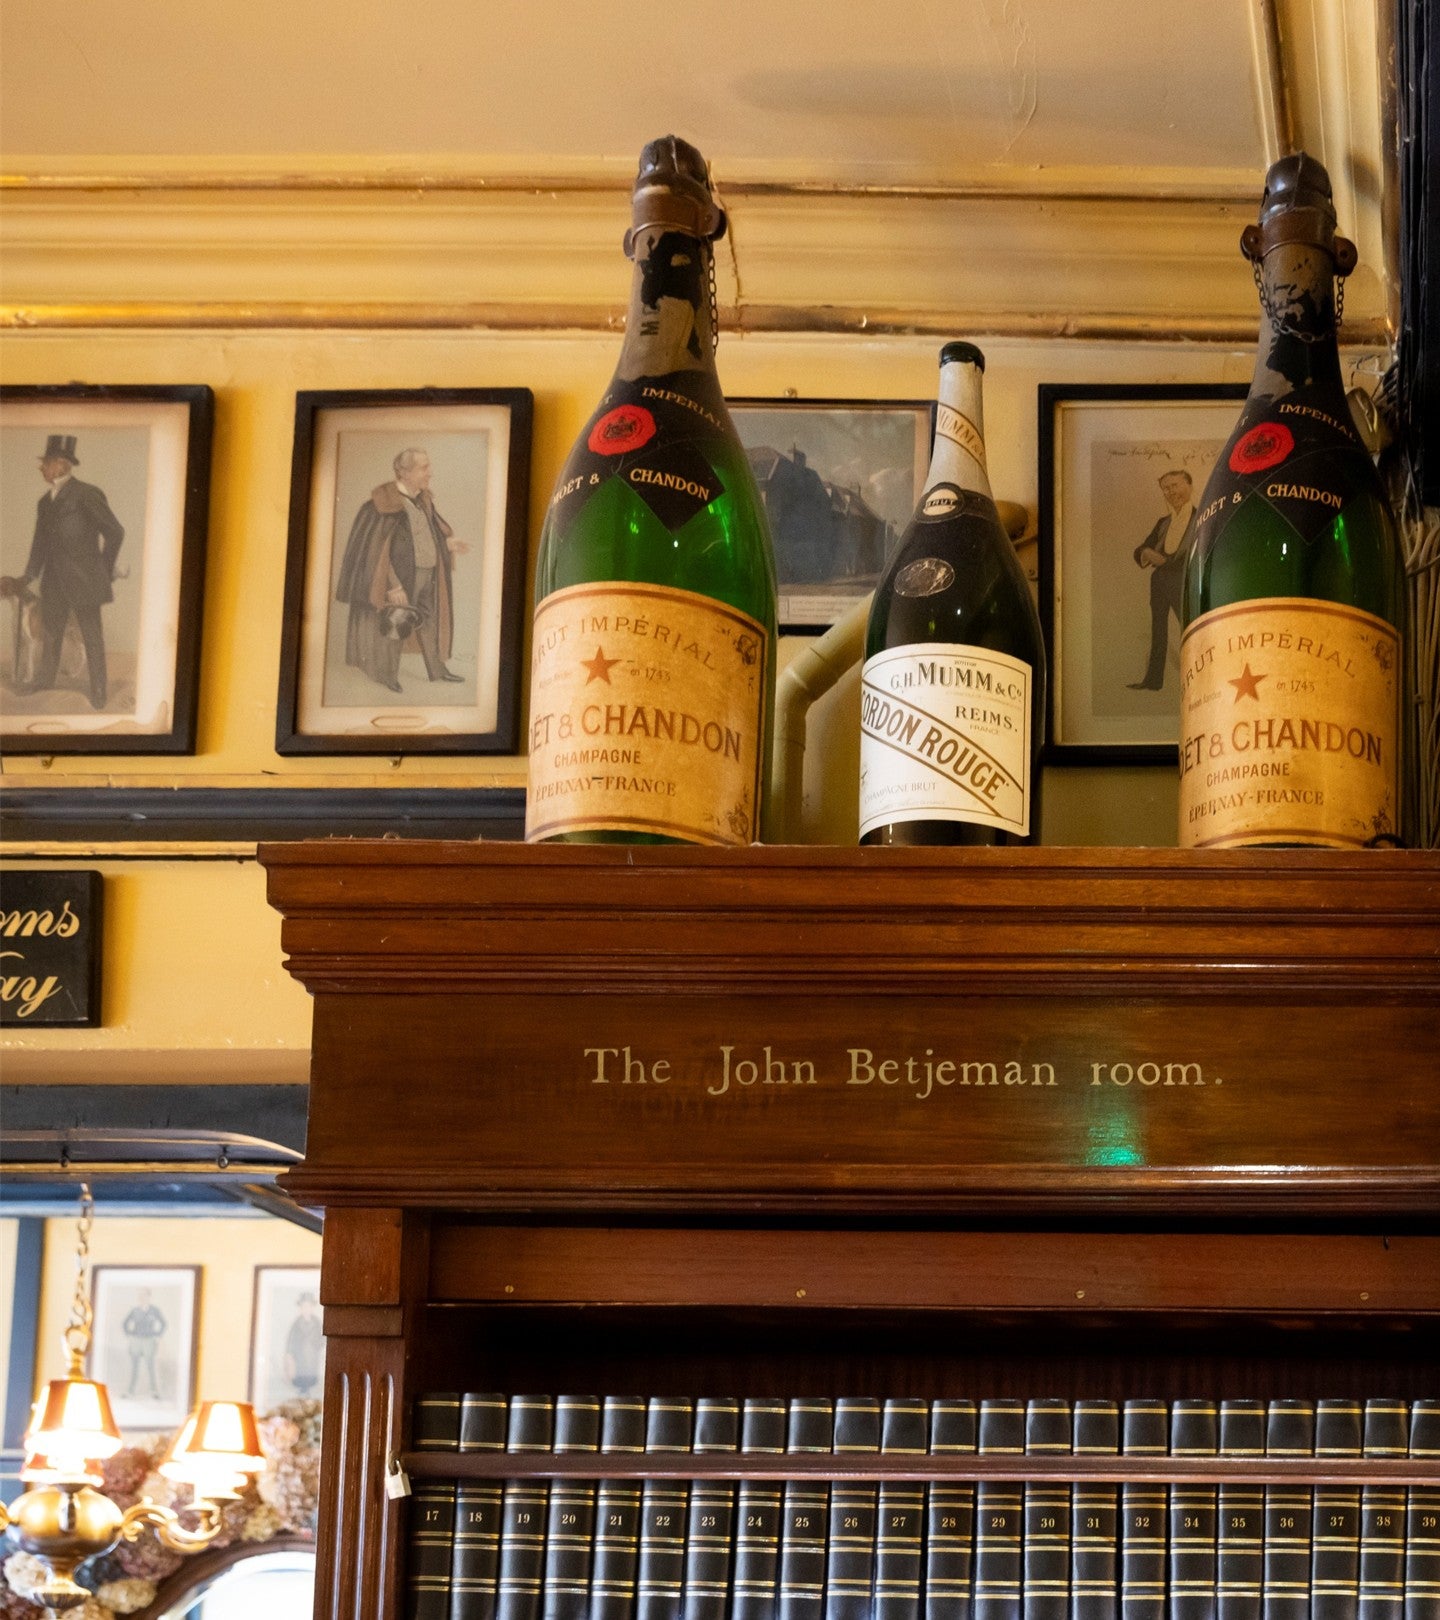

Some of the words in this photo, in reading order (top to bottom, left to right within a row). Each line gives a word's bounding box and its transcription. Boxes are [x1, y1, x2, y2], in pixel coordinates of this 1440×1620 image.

[589, 472, 600, 485] &
[629, 467, 710, 501] CHANDON
[1232, 491, 1243, 504] &
[1267, 483, 1342, 509] CHANDON
[581, 614, 717, 672] IMPÉRIAL
[1227, 628, 1357, 679] IMPÉRIAL
[862, 690, 922, 746] ORDON
[557, 712, 574, 740] &
[581, 703, 743, 764] CHANDON
[1208, 732, 1224, 758] &
[1231, 717, 1383, 767] CHANDON
[554, 748, 642, 768] CHAMPAGNE
[1206, 762, 1291, 788] CHAMPAGNE
[583, 1045, 672, 1084] The
[706, 1045, 818, 1096] John
[845, 1048, 1059, 1099] Betjeman
[1089, 1061, 1224, 1086] room.
[425, 1510, 439, 1521] 17
[469, 1511, 483, 1523] 18
[517, 1513, 531, 1524] 19
[561, 1514, 576, 1525] 20
[609, 1515, 623, 1526] 21
[655, 1515, 671, 1527] 22
[701, 1516, 716, 1527] 23
[747, 1516, 763, 1527] 24
[794, 1517, 809, 1528] 25
[843, 1517, 858, 1528] 26
[891, 1516, 907, 1527] 27
[941, 1517, 956, 1528] 28
[991, 1517, 1006, 1528] 29
[1040, 1517, 1056, 1528] 30
[1086, 1518, 1100, 1528] 31
[1135, 1517, 1150, 1527] 32
[1184, 1517, 1200, 1528] 34
[1231, 1517, 1246, 1528] 35
[1279, 1517, 1294, 1528] 36
[1329, 1516, 1345, 1527] 37
[1376, 1516, 1391, 1527] 38
[1421, 1516, 1437, 1527] 39
